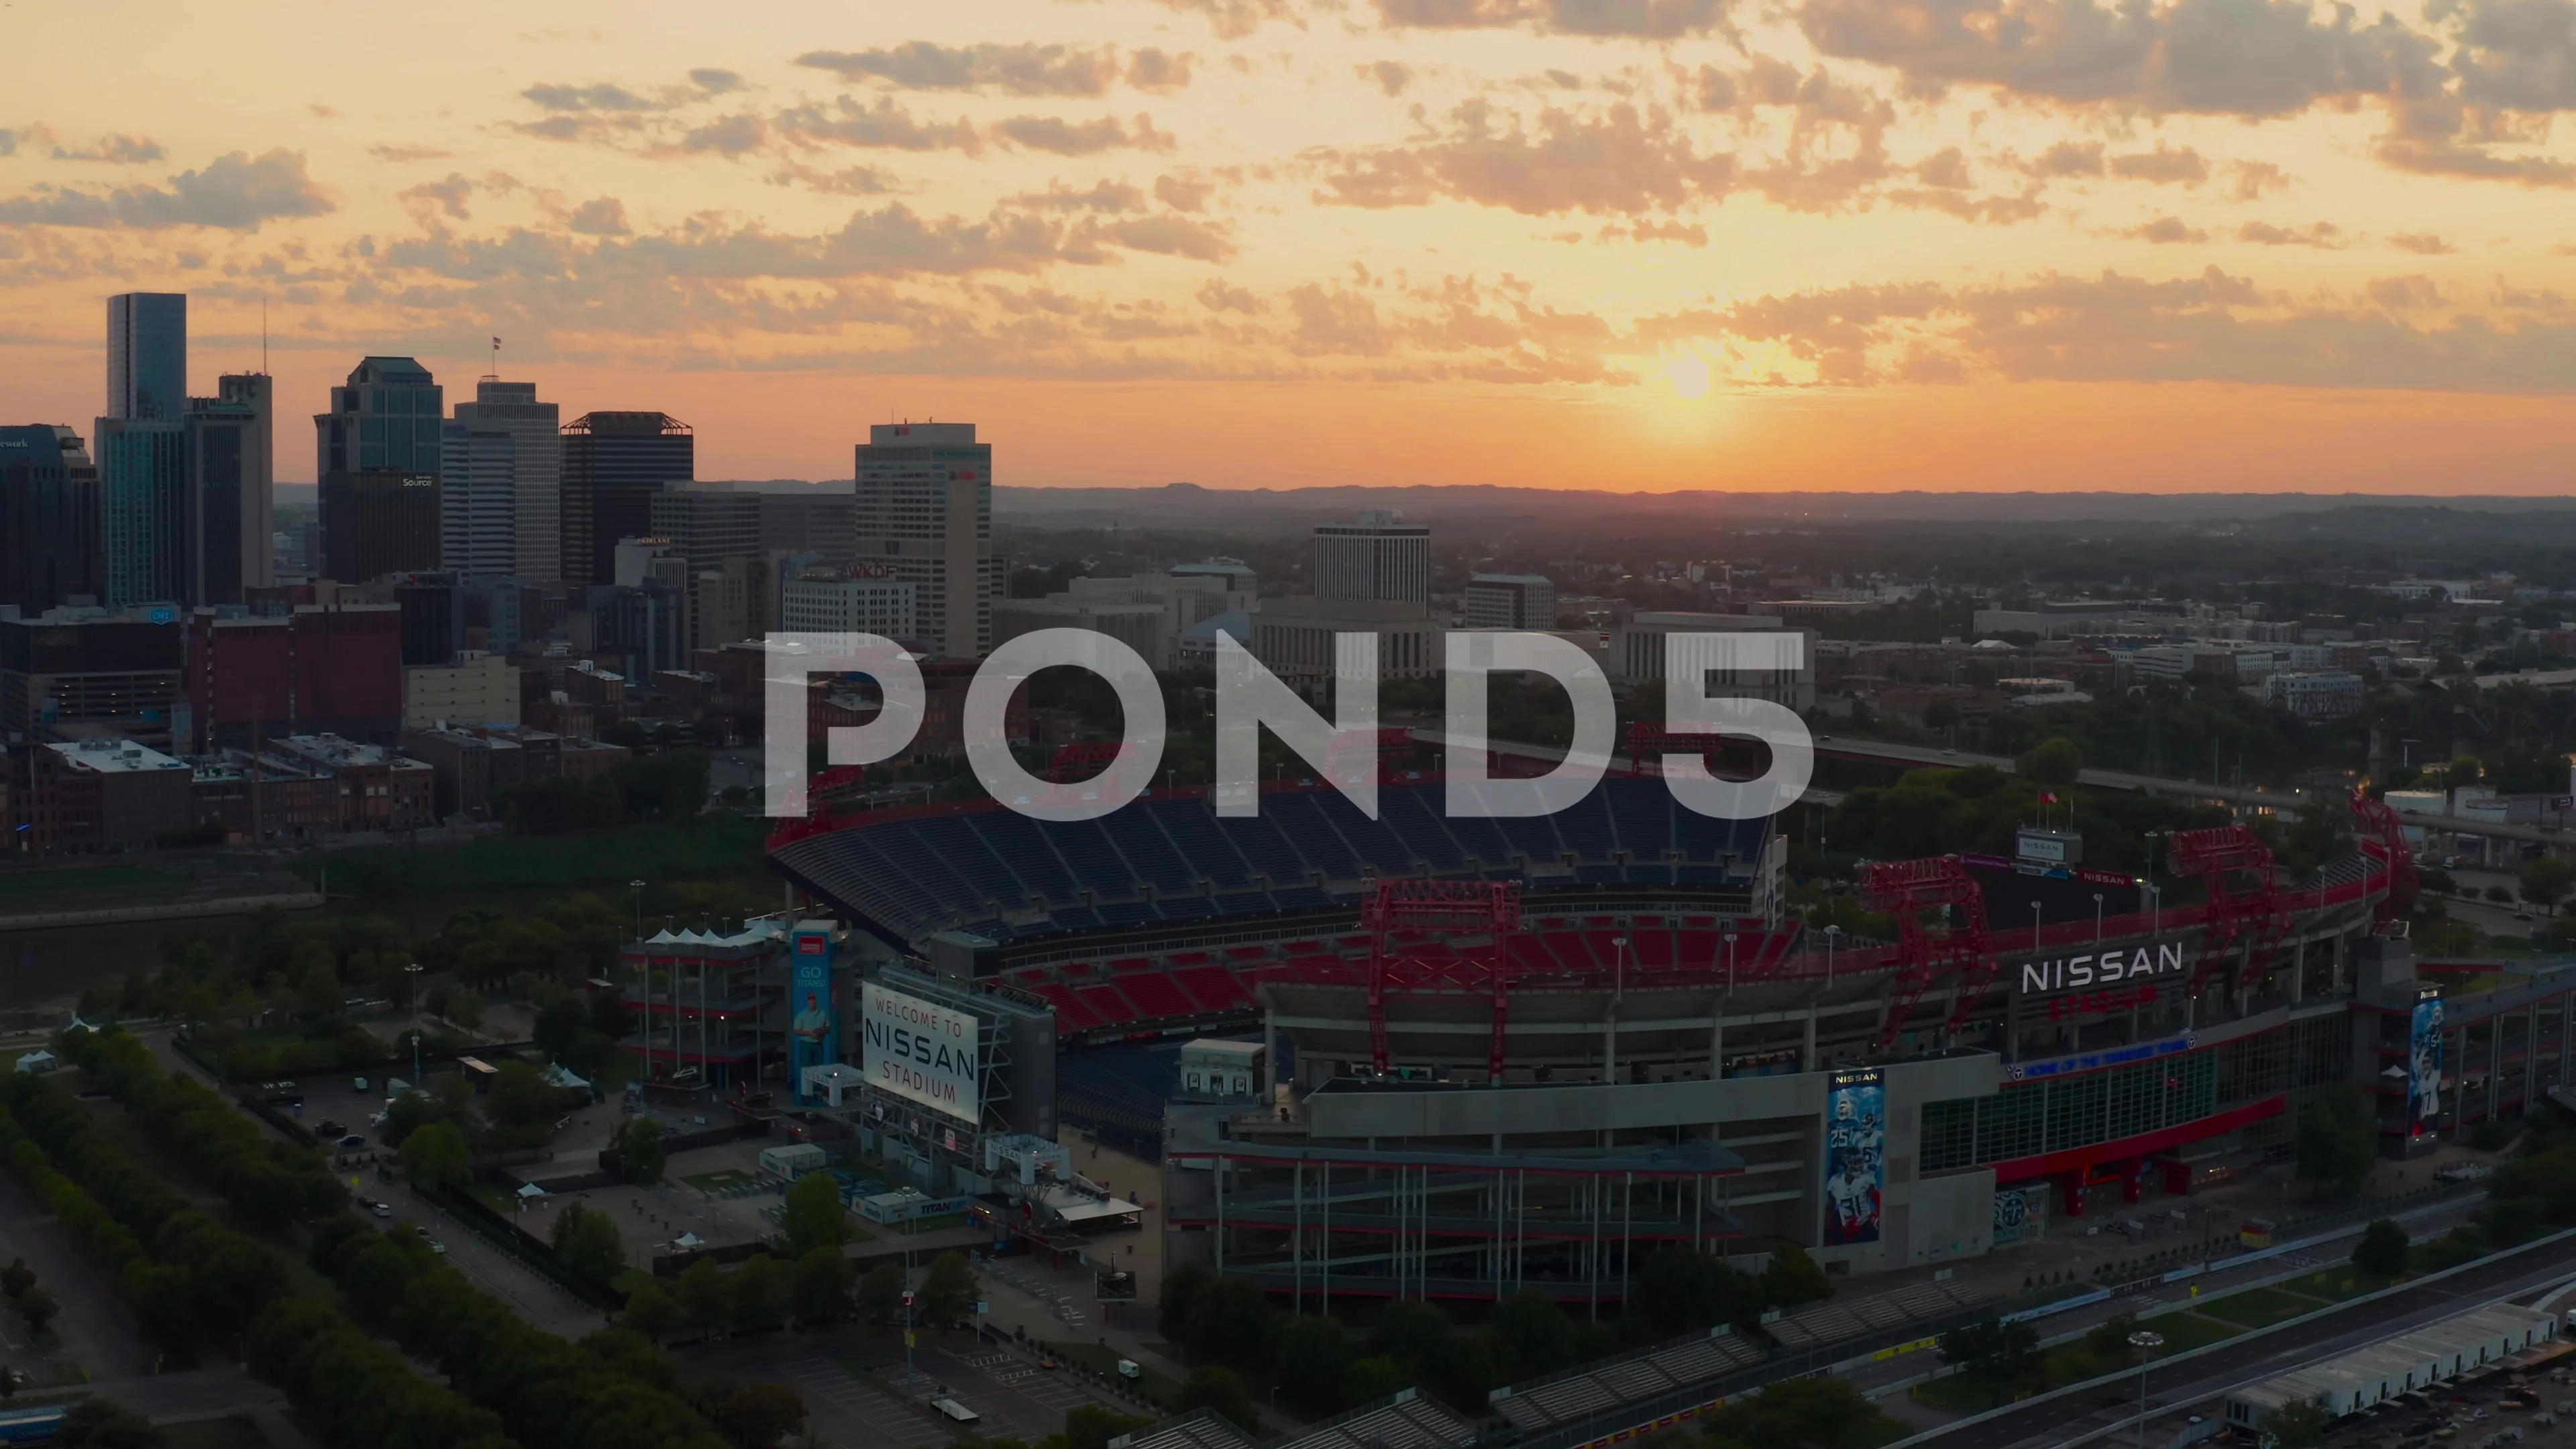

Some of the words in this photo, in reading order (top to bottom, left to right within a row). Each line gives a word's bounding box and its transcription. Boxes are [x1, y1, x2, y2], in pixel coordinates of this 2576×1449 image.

[402, 478, 432, 486] Source
[849, 564, 897, 579] WKDF
[152, 611, 169, 620] CMT
[2024, 841, 2059, 851] NISSAN
[2084, 873, 2125, 885] NISSAN
[800, 966, 822, 979] GO
[2022, 942, 2182, 994] NISSAN
[875, 997, 938, 1030] WELCOME
[945, 1019, 961, 1038] TO
[865, 1017, 974, 1081] NISSAN
[882, 1060, 955, 1104] STADIUM
[1835, 1073, 1878, 1084] NISSAN
[1831, 1128, 1849, 1148] 25
[991, 1143, 1020, 1161] NISSAN
[921, 1201, 951, 1214] TITAN
